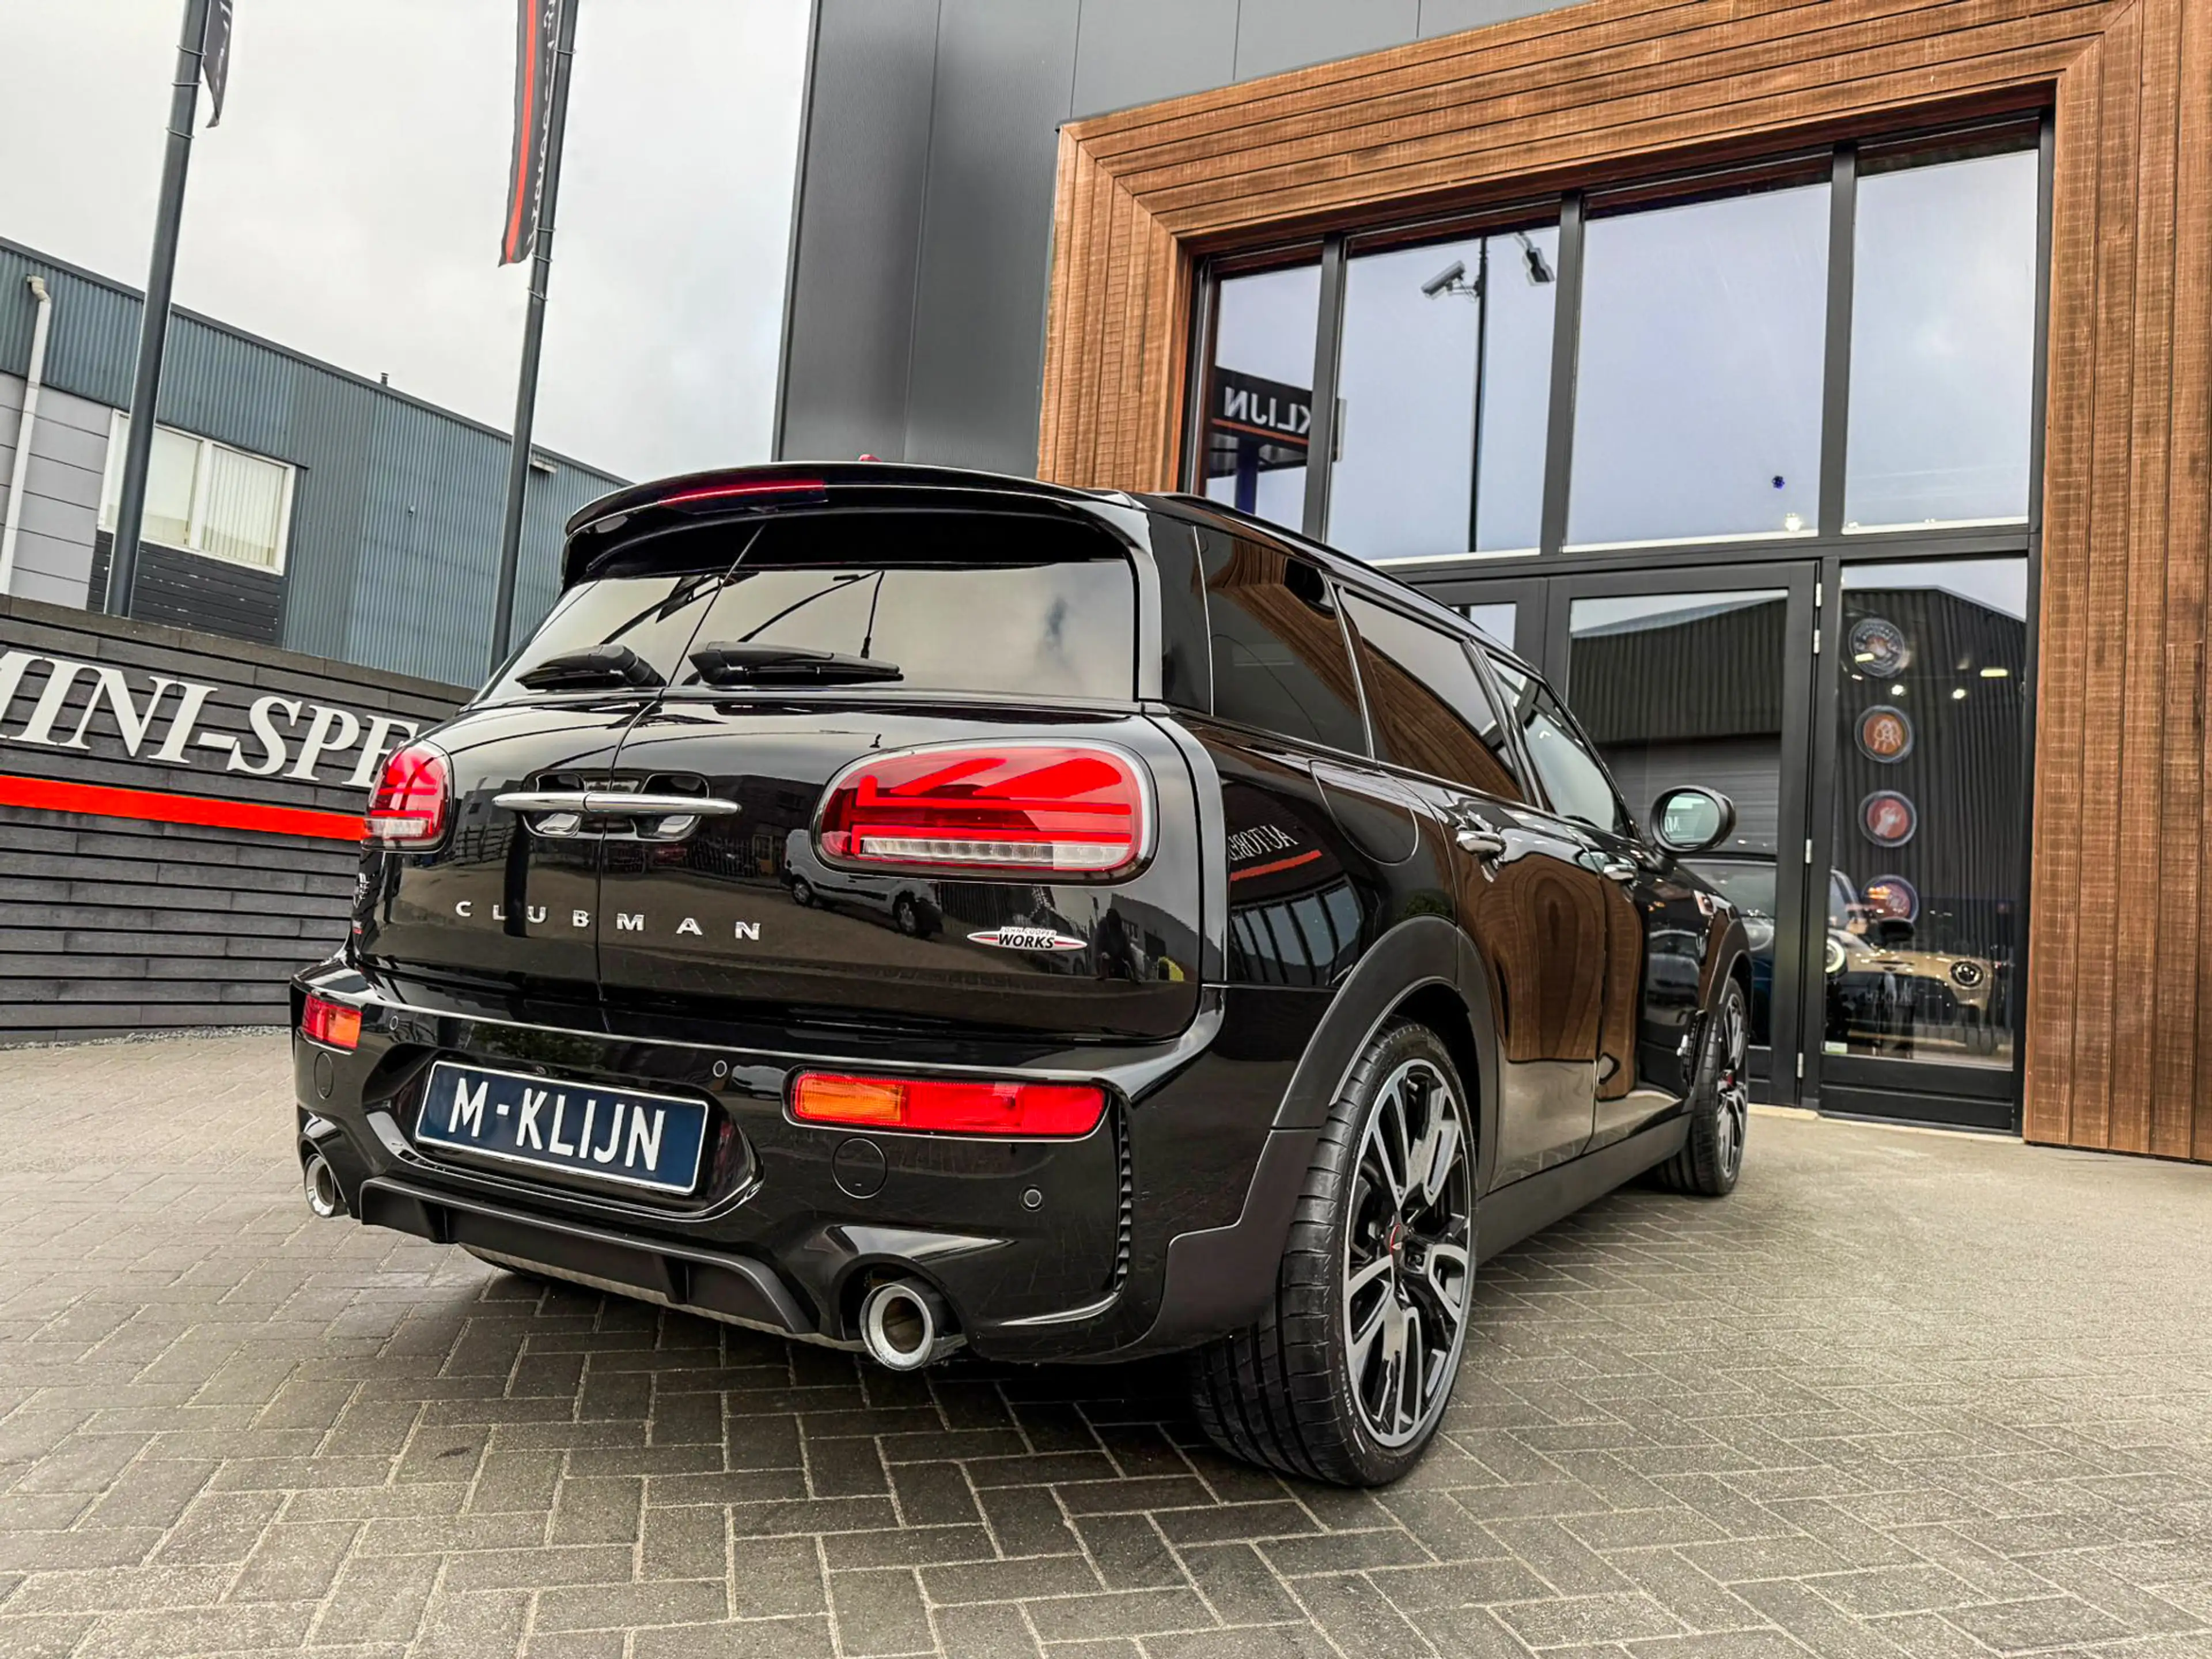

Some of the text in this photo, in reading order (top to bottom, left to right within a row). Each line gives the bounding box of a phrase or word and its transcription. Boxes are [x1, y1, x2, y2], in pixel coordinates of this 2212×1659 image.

[456, 901, 761, 941] CLUBMAN
[1024, 927, 1057, 937] COOPER
[999, 934, 1055, 949] WORKS
